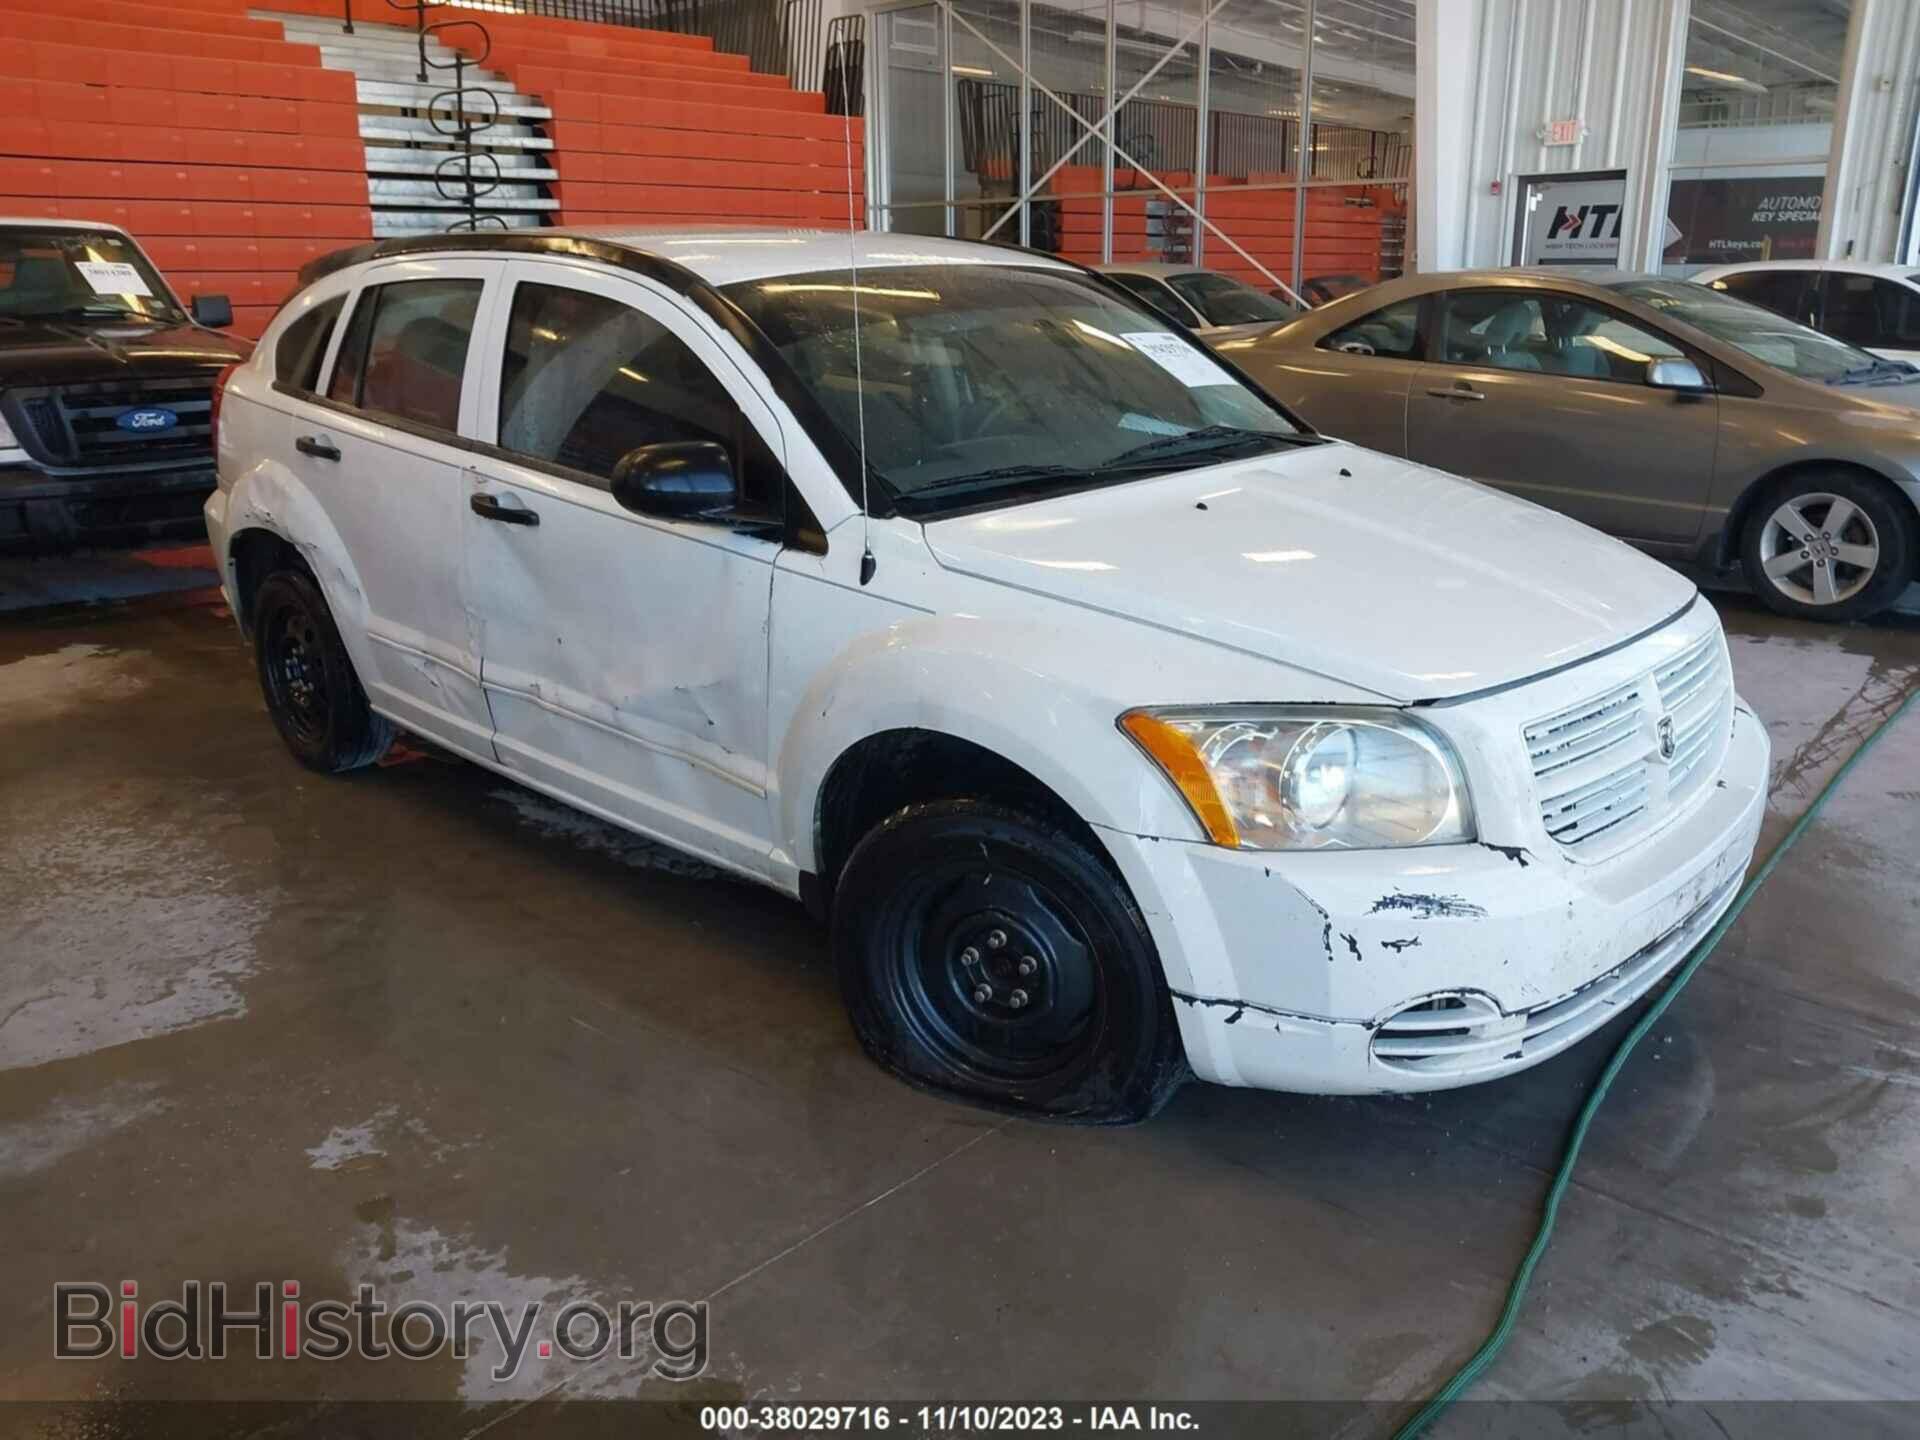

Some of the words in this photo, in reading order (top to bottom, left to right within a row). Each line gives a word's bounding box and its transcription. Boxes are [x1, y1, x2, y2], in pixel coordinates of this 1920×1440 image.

[1552, 122, 1577, 143] EXIT
[1758, 195, 1821, 210] AUTOMO
[1752, 211, 1776, 222] KEY
[132, 413, 165, 428] Ford
